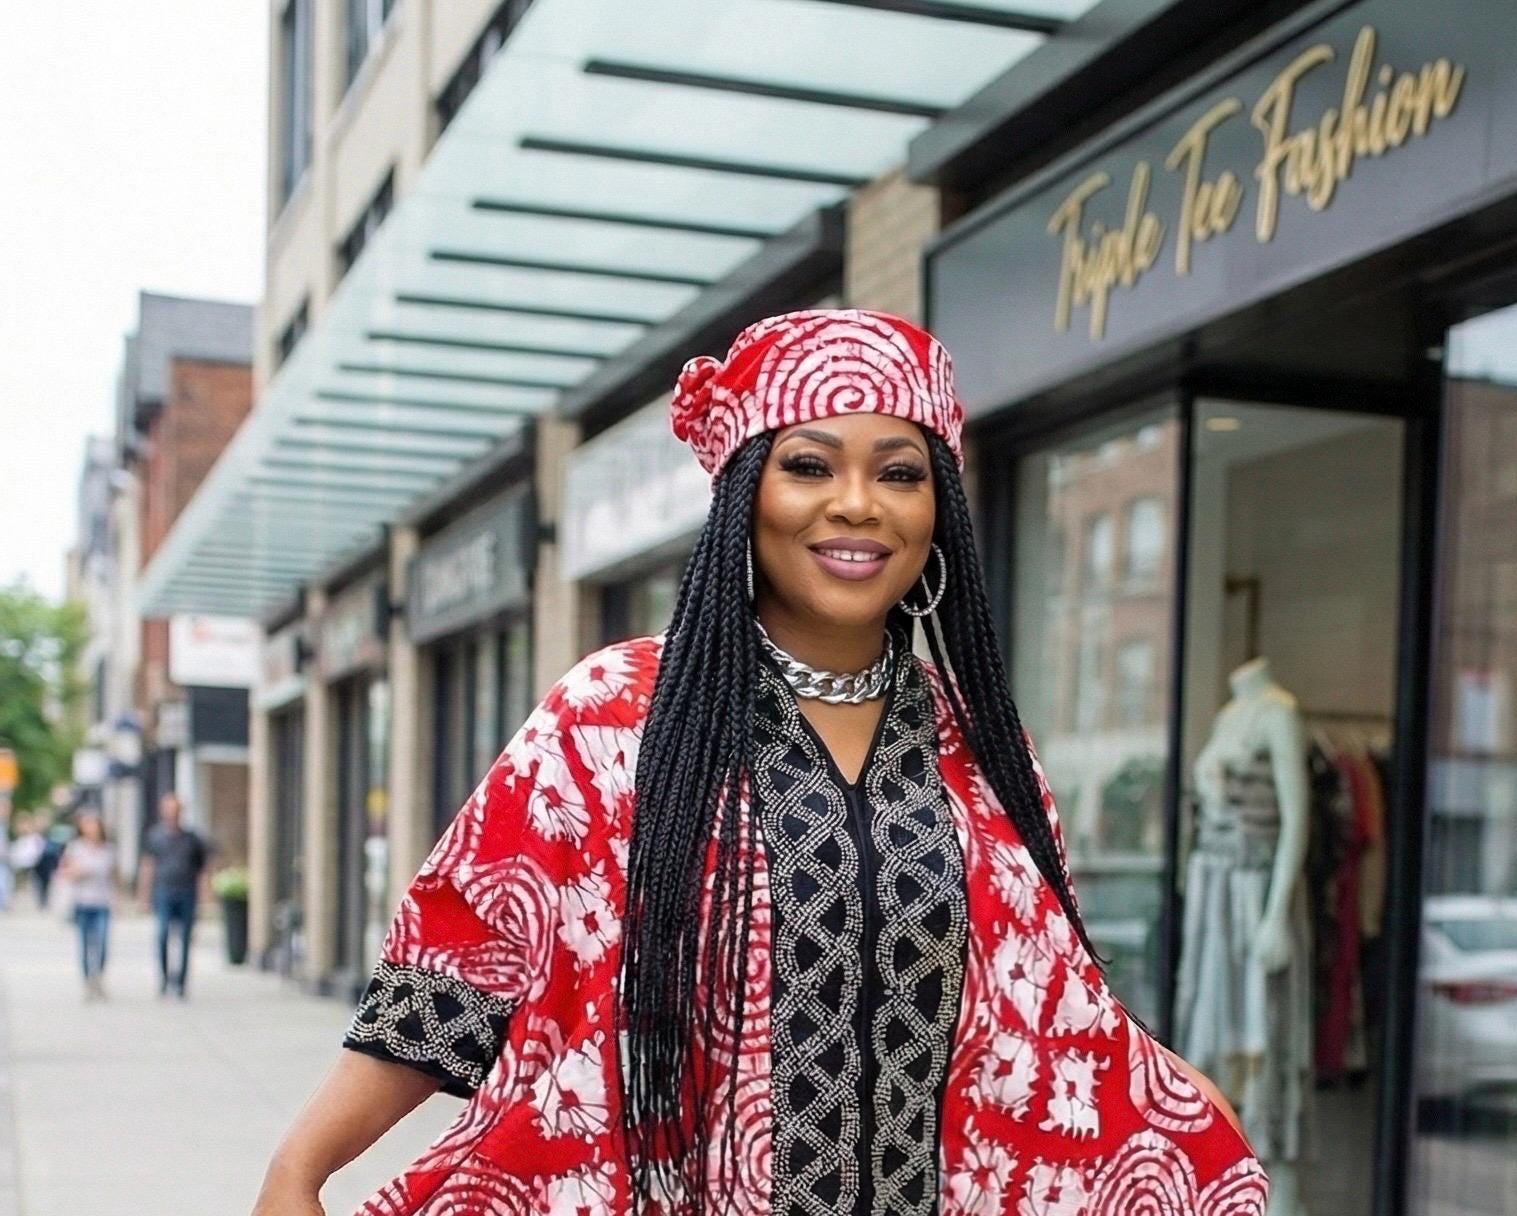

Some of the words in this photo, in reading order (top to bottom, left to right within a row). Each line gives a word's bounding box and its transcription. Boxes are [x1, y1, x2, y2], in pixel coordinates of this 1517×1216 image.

[1047, 160, 1164, 341] Triple
[1166, 98, 1243, 276] Tee
[1252, 25, 1465, 243] Fashion
